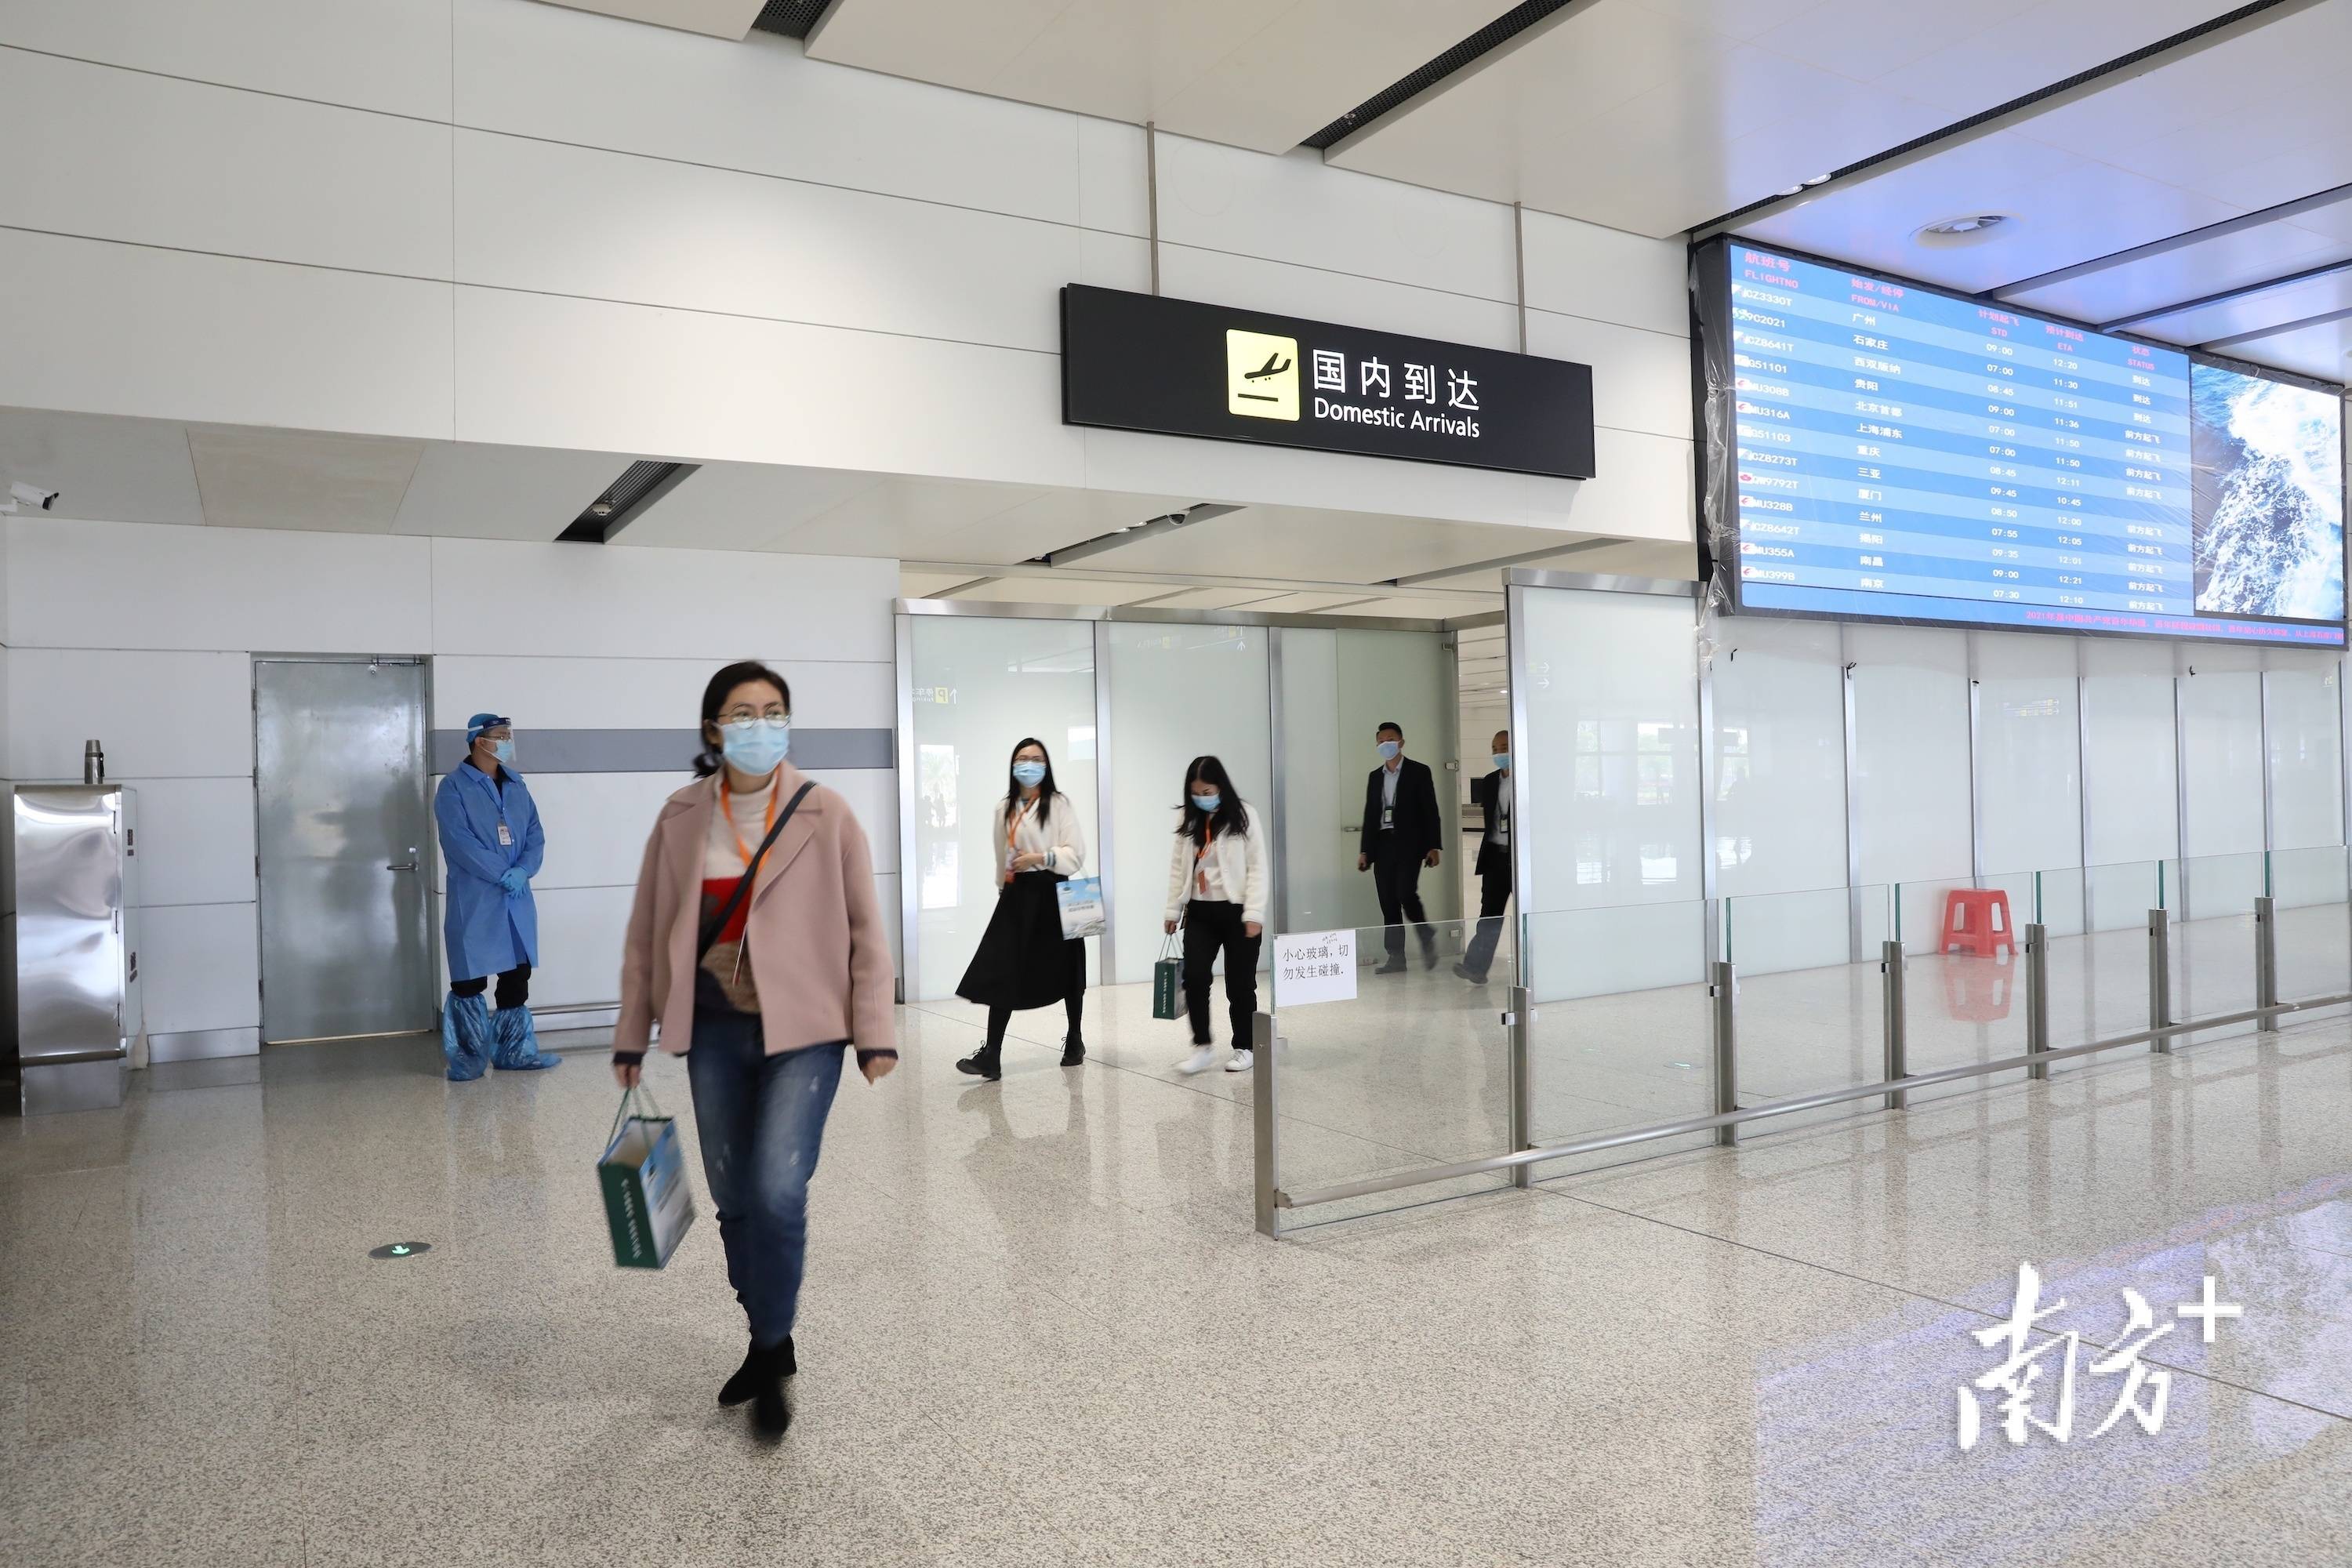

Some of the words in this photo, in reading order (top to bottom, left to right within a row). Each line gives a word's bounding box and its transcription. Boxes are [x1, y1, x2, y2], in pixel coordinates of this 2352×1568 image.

[1745, 251, 1791, 272] 航班号
[1744, 270, 1798, 289] FLIGHTNO
[1852, 295, 1899, 312] FROM/VIA
[1991, 327, 2007, 337] STD
[2057, 343, 2073, 351] ETA
[2128, 358, 2155, 370] STATUS
[1853, 314, 1875, 326] 广州
[1987, 343, 2013, 356] 09:00
[2053, 358, 2078, 370] 12:20
[2132, 375, 2151, 387] 到达
[1853, 334, 1888, 350] 石家庄
[1987, 364, 2013, 376] 07:00
[2054, 378, 2078, 389] 11:30
[2132, 394, 2151, 405] 到达
[1312, 349, 1480, 411] 国内到达
[1853, 356, 1900, 375] 西双版纳
[1987, 384, 2013, 397] 08:45
[2054, 397, 2078, 408] 11:51
[2133, 412, 2151, 423] 到达
[1314, 397, 1405, 429] Domestic
[1410, 410, 1480, 438] Arrivals
[1855, 379, 1878, 391] 贵阳
[1988, 405, 2015, 417] 09:00
[2054, 417, 2079, 428] 11:36
[2125, 430, 2161, 445] 前方起飞
[1857, 401, 1902, 417] 北京首都
[1989, 425, 2015, 437] 07:00
[2056, 437, 2079, 448] 11:50
[2125, 449, 2161, 463] 前方起飞
[1857, 423, 1902, 439] 上海浦东
[1990, 445, 2016, 457] 07:00
[2056, 457, 2081, 467] 11:50
[2126, 467, 2161, 481] 前方起飞
[1857, 445, 1881, 458] 重庆
[1990, 466, 2016, 477] 08:45
[2057, 477, 2079, 487] 12:11
[2126, 487, 2162, 500] 前方起飞
[1857, 467, 1882, 480] 三亚
[1991, 486, 2017, 498] 09:45
[2057, 496, 2082, 506] 10:45
[1858, 489, 1882, 501] 厦门
[1991, 507, 2018, 518] 08:50
[2057, 516, 2082, 526] 12:00
[2127, 525, 2162, 538] 前方起飞
[1859, 511, 1882, 523] 兰州
[1991, 528, 2018, 539] 07:55
[2058, 536, 2082, 546] 12:05
[2128, 543, 2162, 556] 前方起飞
[1860, 555, 1883, 567] 南昌
[1993, 569, 2020, 579] 09:00
[2059, 575, 2082, 585] 12:21
[2129, 582, 2164, 593] 前方起飞
[1992, 549, 2019, 559] 09:35
[2059, 556, 2082, 564] 12:01
[2128, 563, 2163, 574] 前方起飞
[1861, 577, 1884, 588] 南京
[1993, 590, 2020, 599] 07:30
[2059, 596, 2083, 604] 12:10
[2129, 601, 2164, 612] 前方起飞
